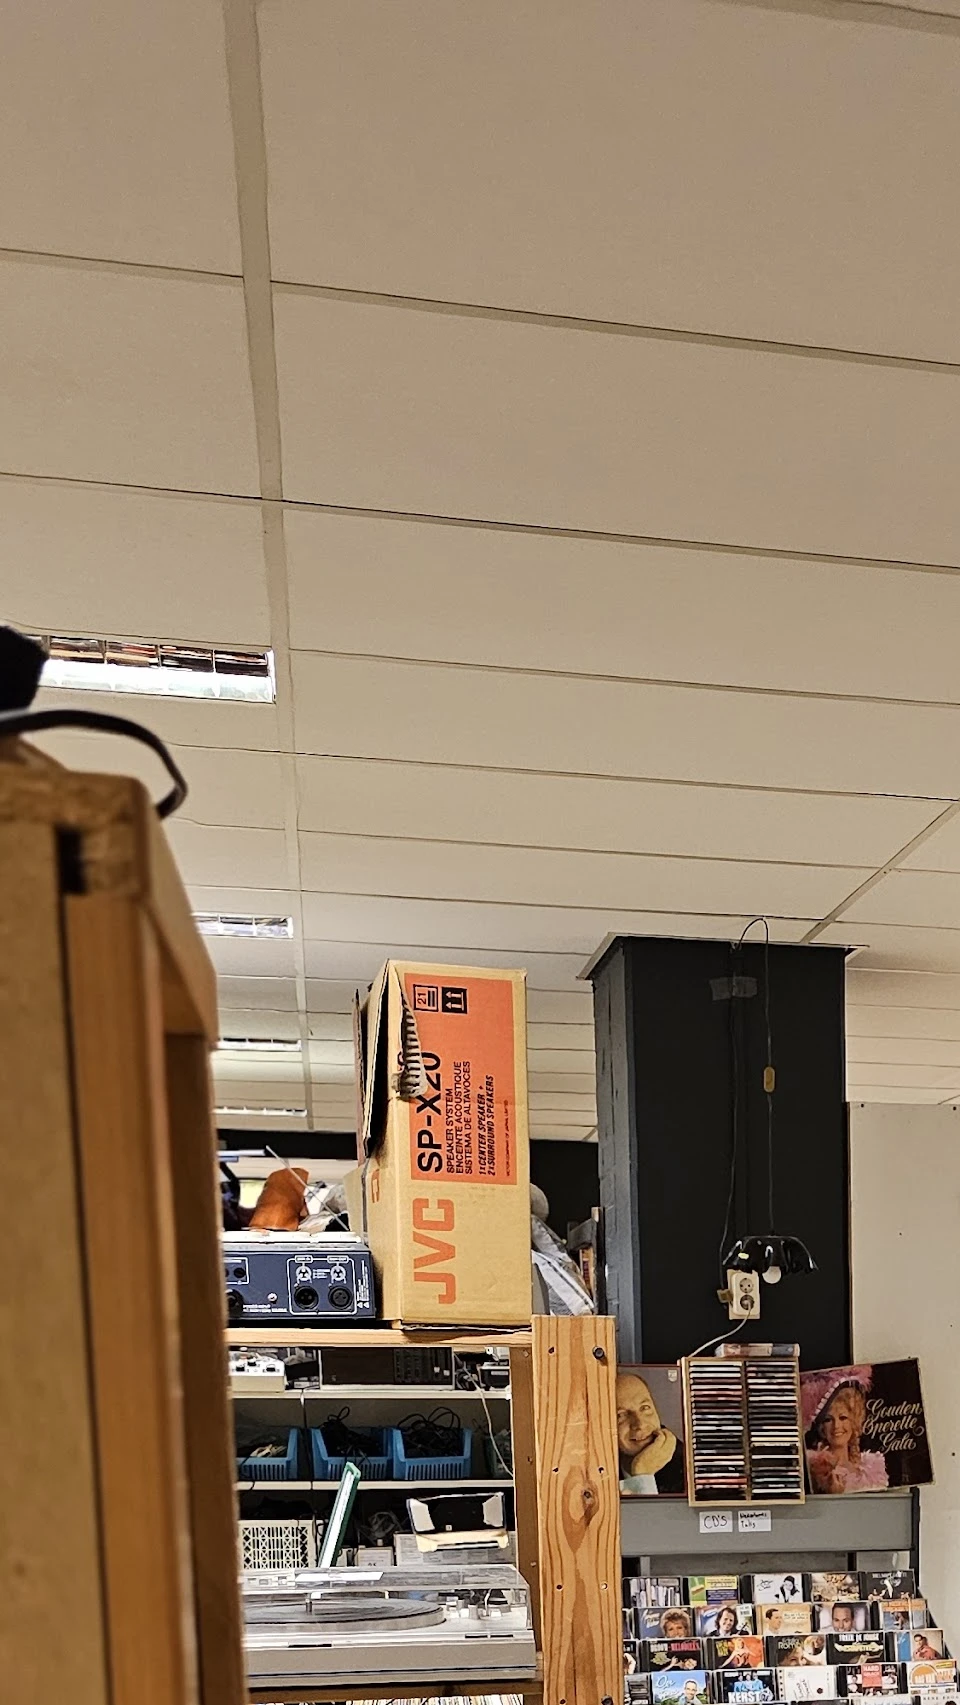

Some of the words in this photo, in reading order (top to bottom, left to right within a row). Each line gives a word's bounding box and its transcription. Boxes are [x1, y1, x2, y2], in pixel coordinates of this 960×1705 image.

[444, 1088, 454, 1127] SYSTEM
[453, 1061, 463, 1124] ACOUSTIQUE
[462, 1061, 471, 1115] ALTAVOCES
[485, 1075, 494, 1119] SPEAKERS
[463, 1117, 472, 1130] DE
[477, 1093, 486, 1133] SPEAKER
[445, 1128, 455, 1174] SPEAKER
[455, 1126, 464, 1174] ENCEINTE
[464, 1132, 473, 1175] SISTEMA
[412, 1198, 456, 1305] JVC
[862, 1414, 925, 1440] Operette
[865, 1398, 923, 1421] Gouden
[879, 1431, 917, 1454] Gala
[703, 1514, 728, 1529] CD'S
[728, 1691, 761, 1703] KERST
